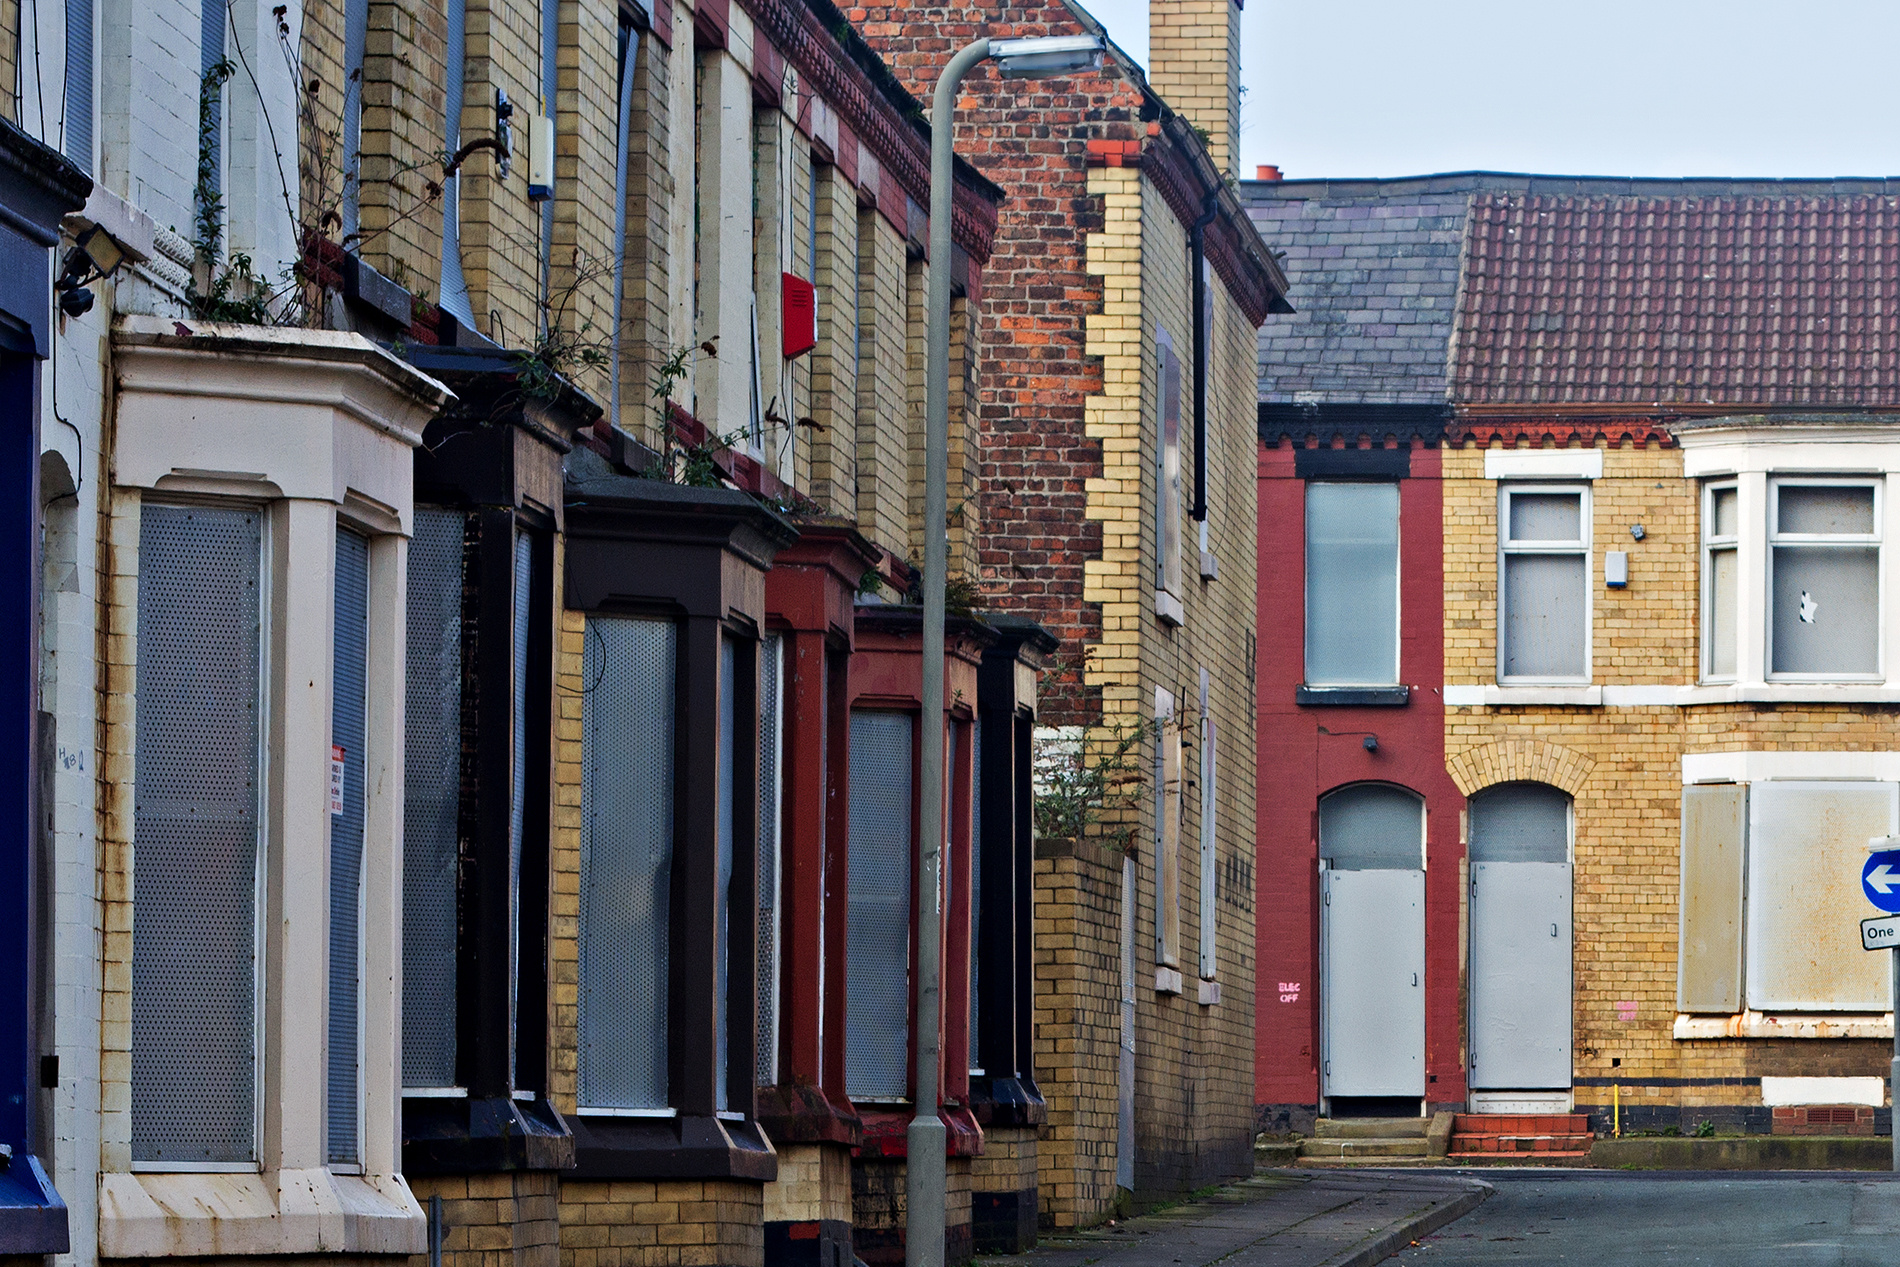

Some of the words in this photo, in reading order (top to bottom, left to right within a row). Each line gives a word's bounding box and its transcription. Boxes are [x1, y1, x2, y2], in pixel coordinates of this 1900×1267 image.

[1867, 927, 1894, 939] One
[1278, 982, 1301, 992] ELEC
[1279, 993, 1299, 1003] OFF
